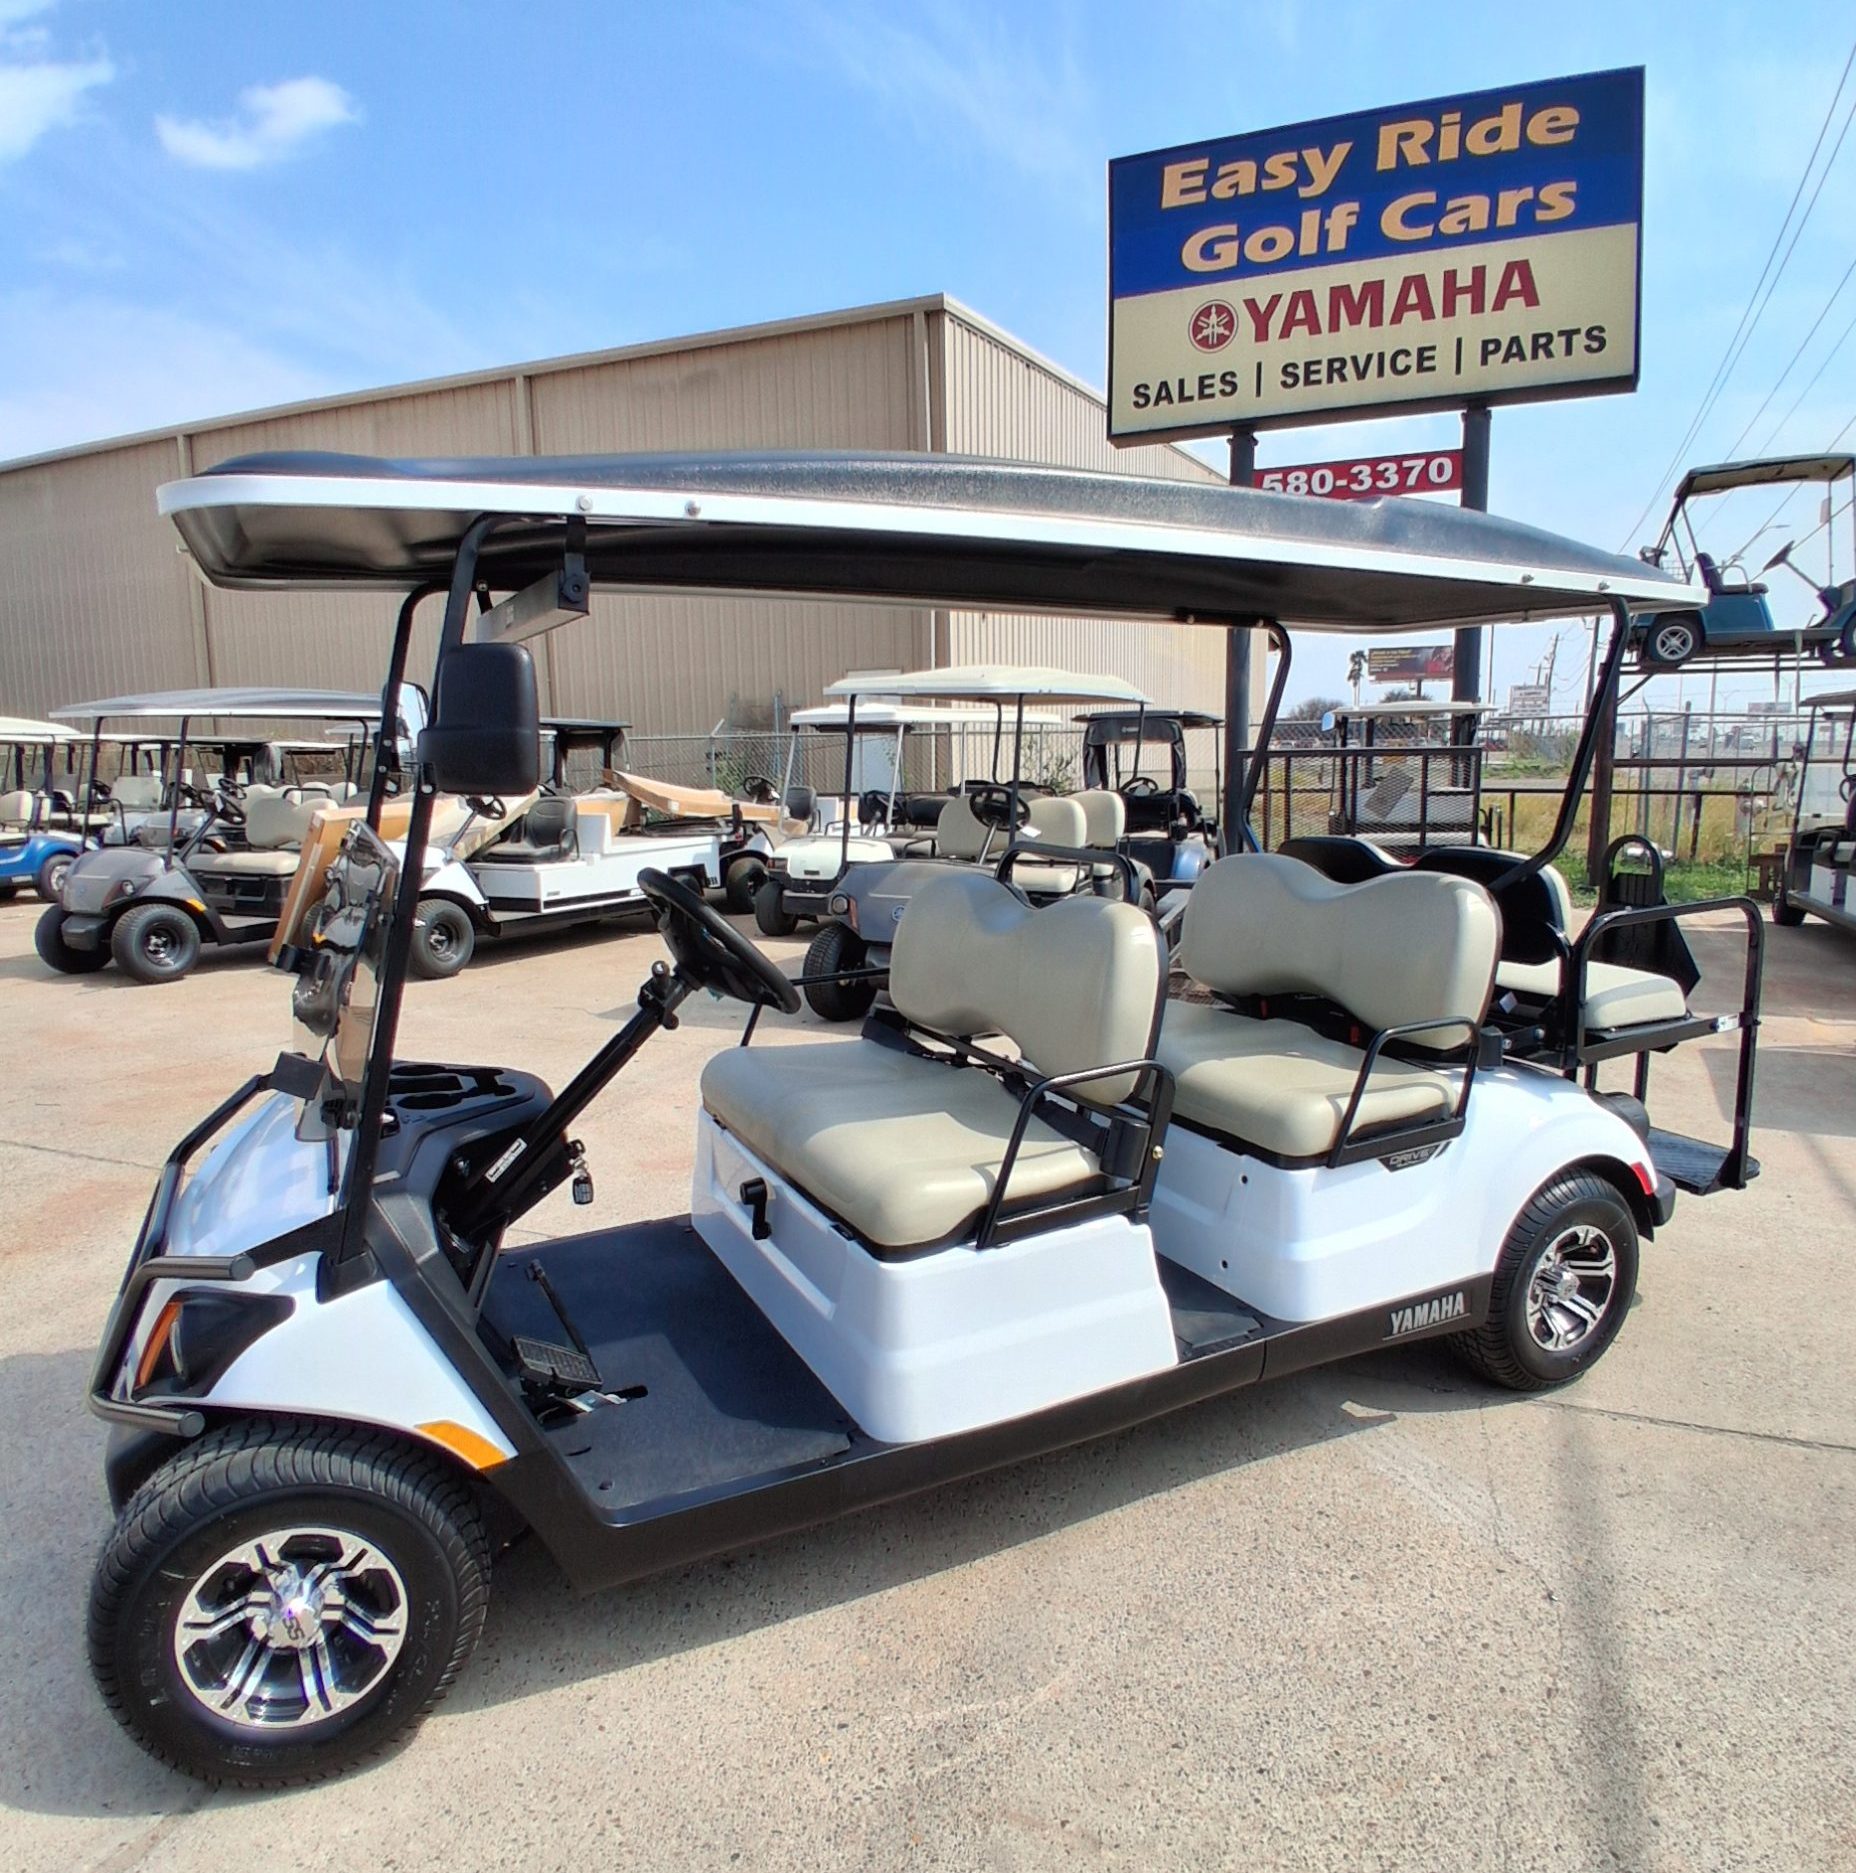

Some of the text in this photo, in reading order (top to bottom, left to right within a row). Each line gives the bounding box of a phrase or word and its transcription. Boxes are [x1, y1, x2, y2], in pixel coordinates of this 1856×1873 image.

[1161, 103, 1580, 209] Easy Ride
[1180, 182, 1578, 273] Golf Cars
[1243, 259, 1540, 343] YAMAHA
[1133, 325, 1607, 410] SALES SERVICE PARTS
[1262, 457, 1453, 496] 580-3370
[1391, 1291, 1465, 1335] YAMAHA
